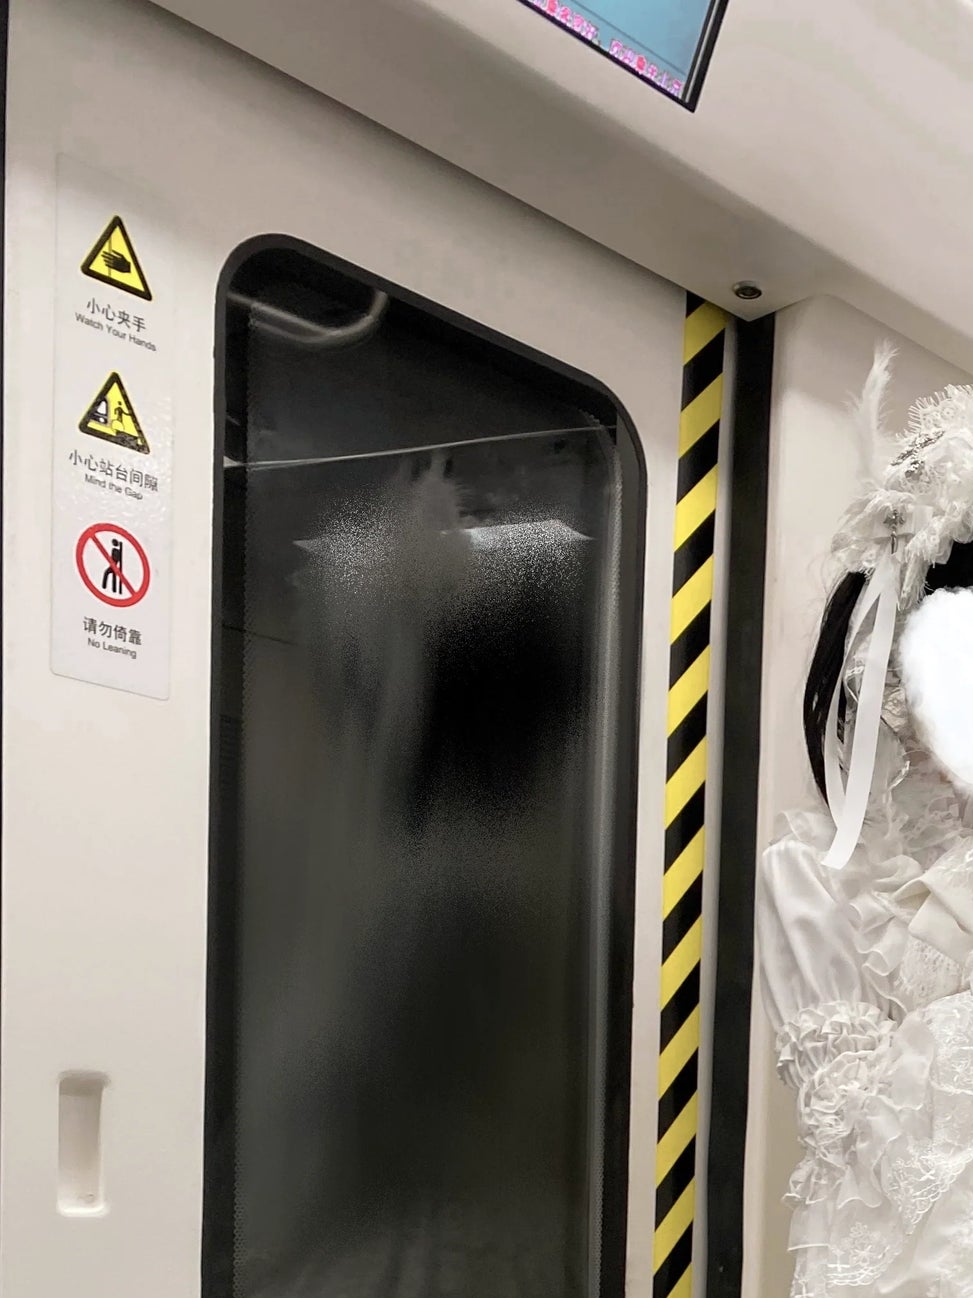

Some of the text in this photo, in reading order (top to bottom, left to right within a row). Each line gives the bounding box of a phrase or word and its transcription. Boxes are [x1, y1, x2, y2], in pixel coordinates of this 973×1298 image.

[86, 297, 146, 332] 小心夹手
[74, 312, 157, 352] Watch Your Hands
[68, 449, 159, 492] 小心站台间隙
[85, 473, 144, 501] Mind the Gap
[83, 616, 142, 646] 请勿倚靠
[87, 637, 137, 660] No Leaning
